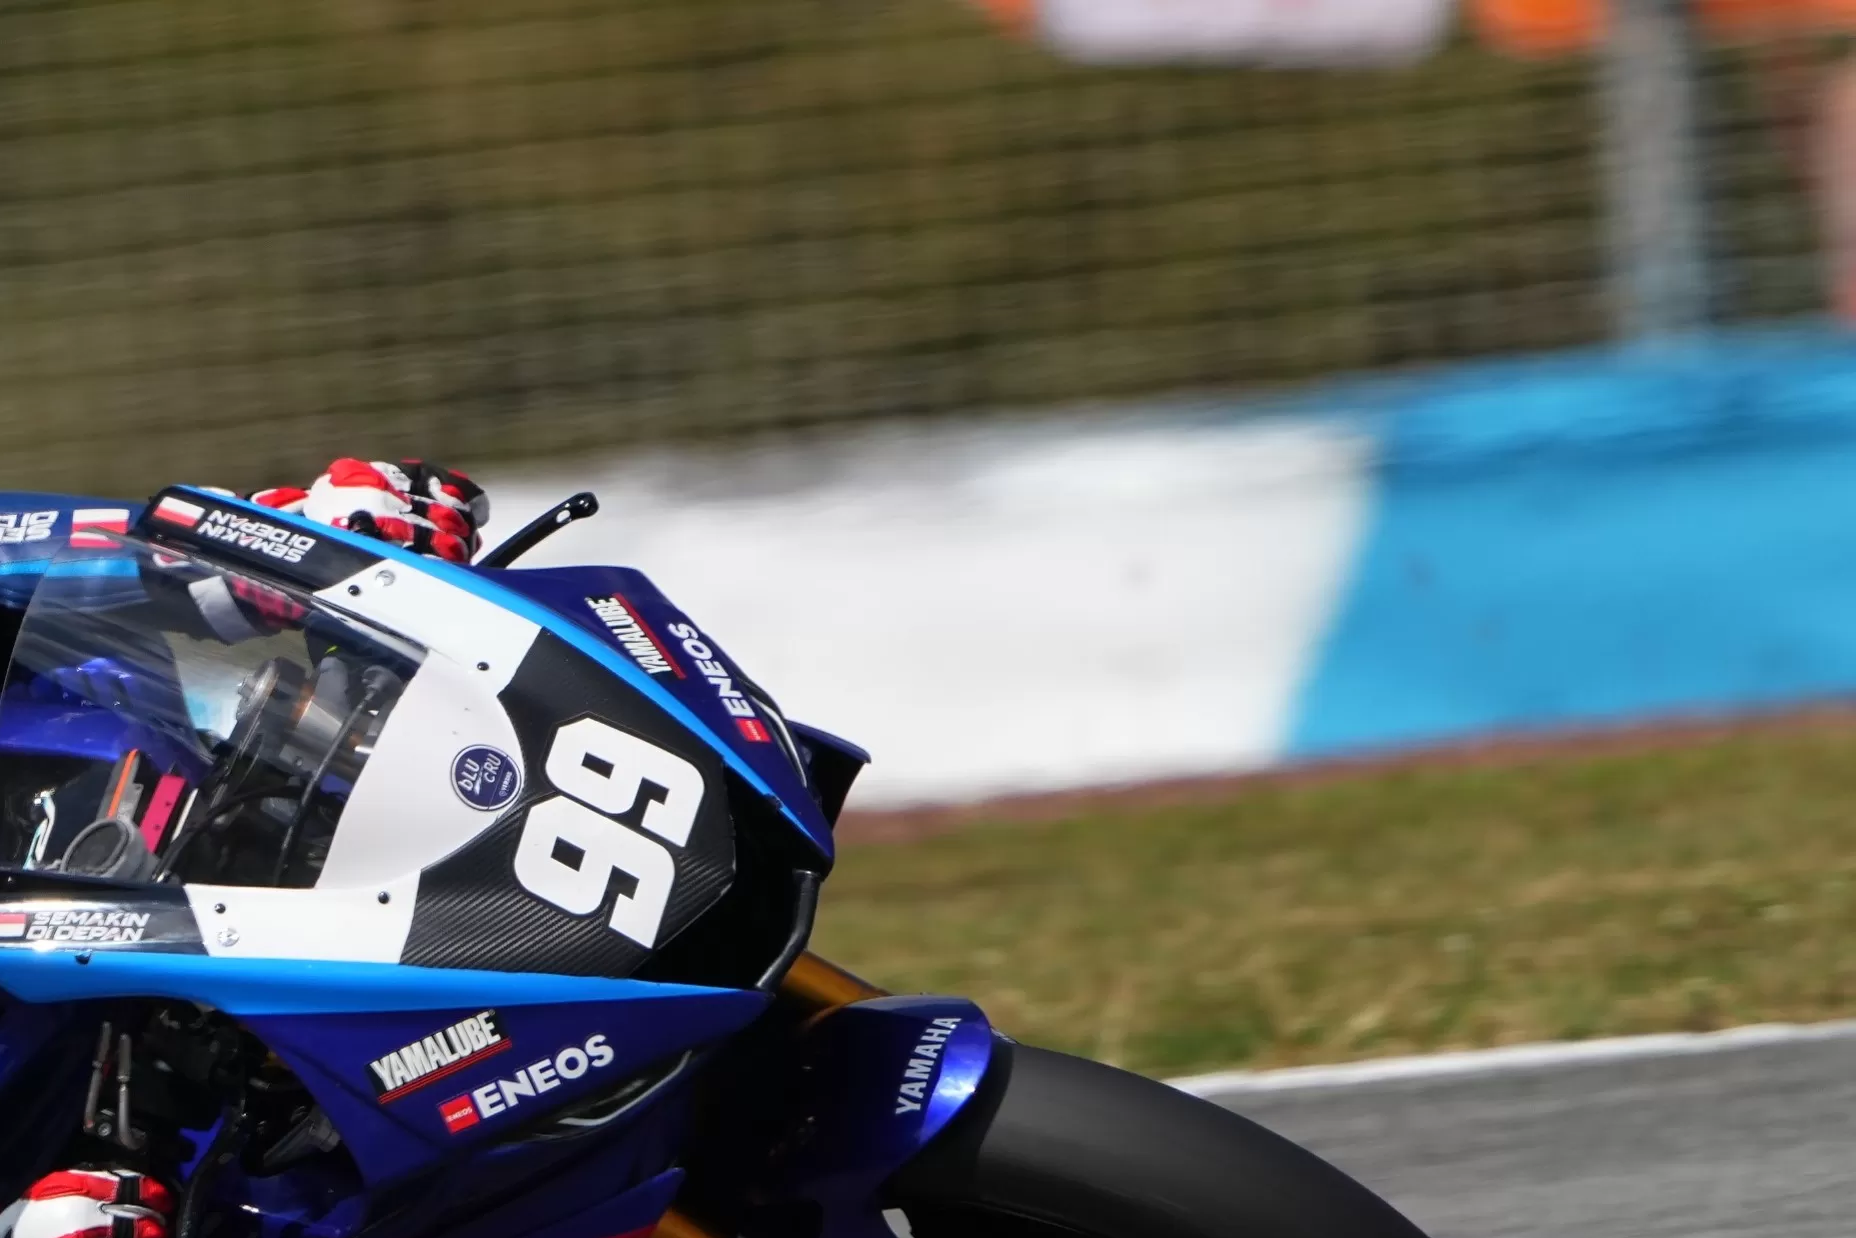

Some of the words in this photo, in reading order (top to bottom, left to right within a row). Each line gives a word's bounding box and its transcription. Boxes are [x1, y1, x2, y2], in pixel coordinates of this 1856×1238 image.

[197, 522, 307, 563] SEMAKIN
[207, 509, 289, 542] DEPAN
[585, 596, 672, 676] YAMALUBE
[668, 622, 755, 718] ENEOS
[514, 717, 705, 949] 99
[26, 926, 56, 941] DI
[58, 926, 145, 942] DEPAN
[33, 912, 150, 928] SEMAKIN
[370, 1010, 501, 1092] YAMALUBE
[474, 1033, 615, 1119] ENEOS
[895, 1015, 961, 1116] YAMAHA
